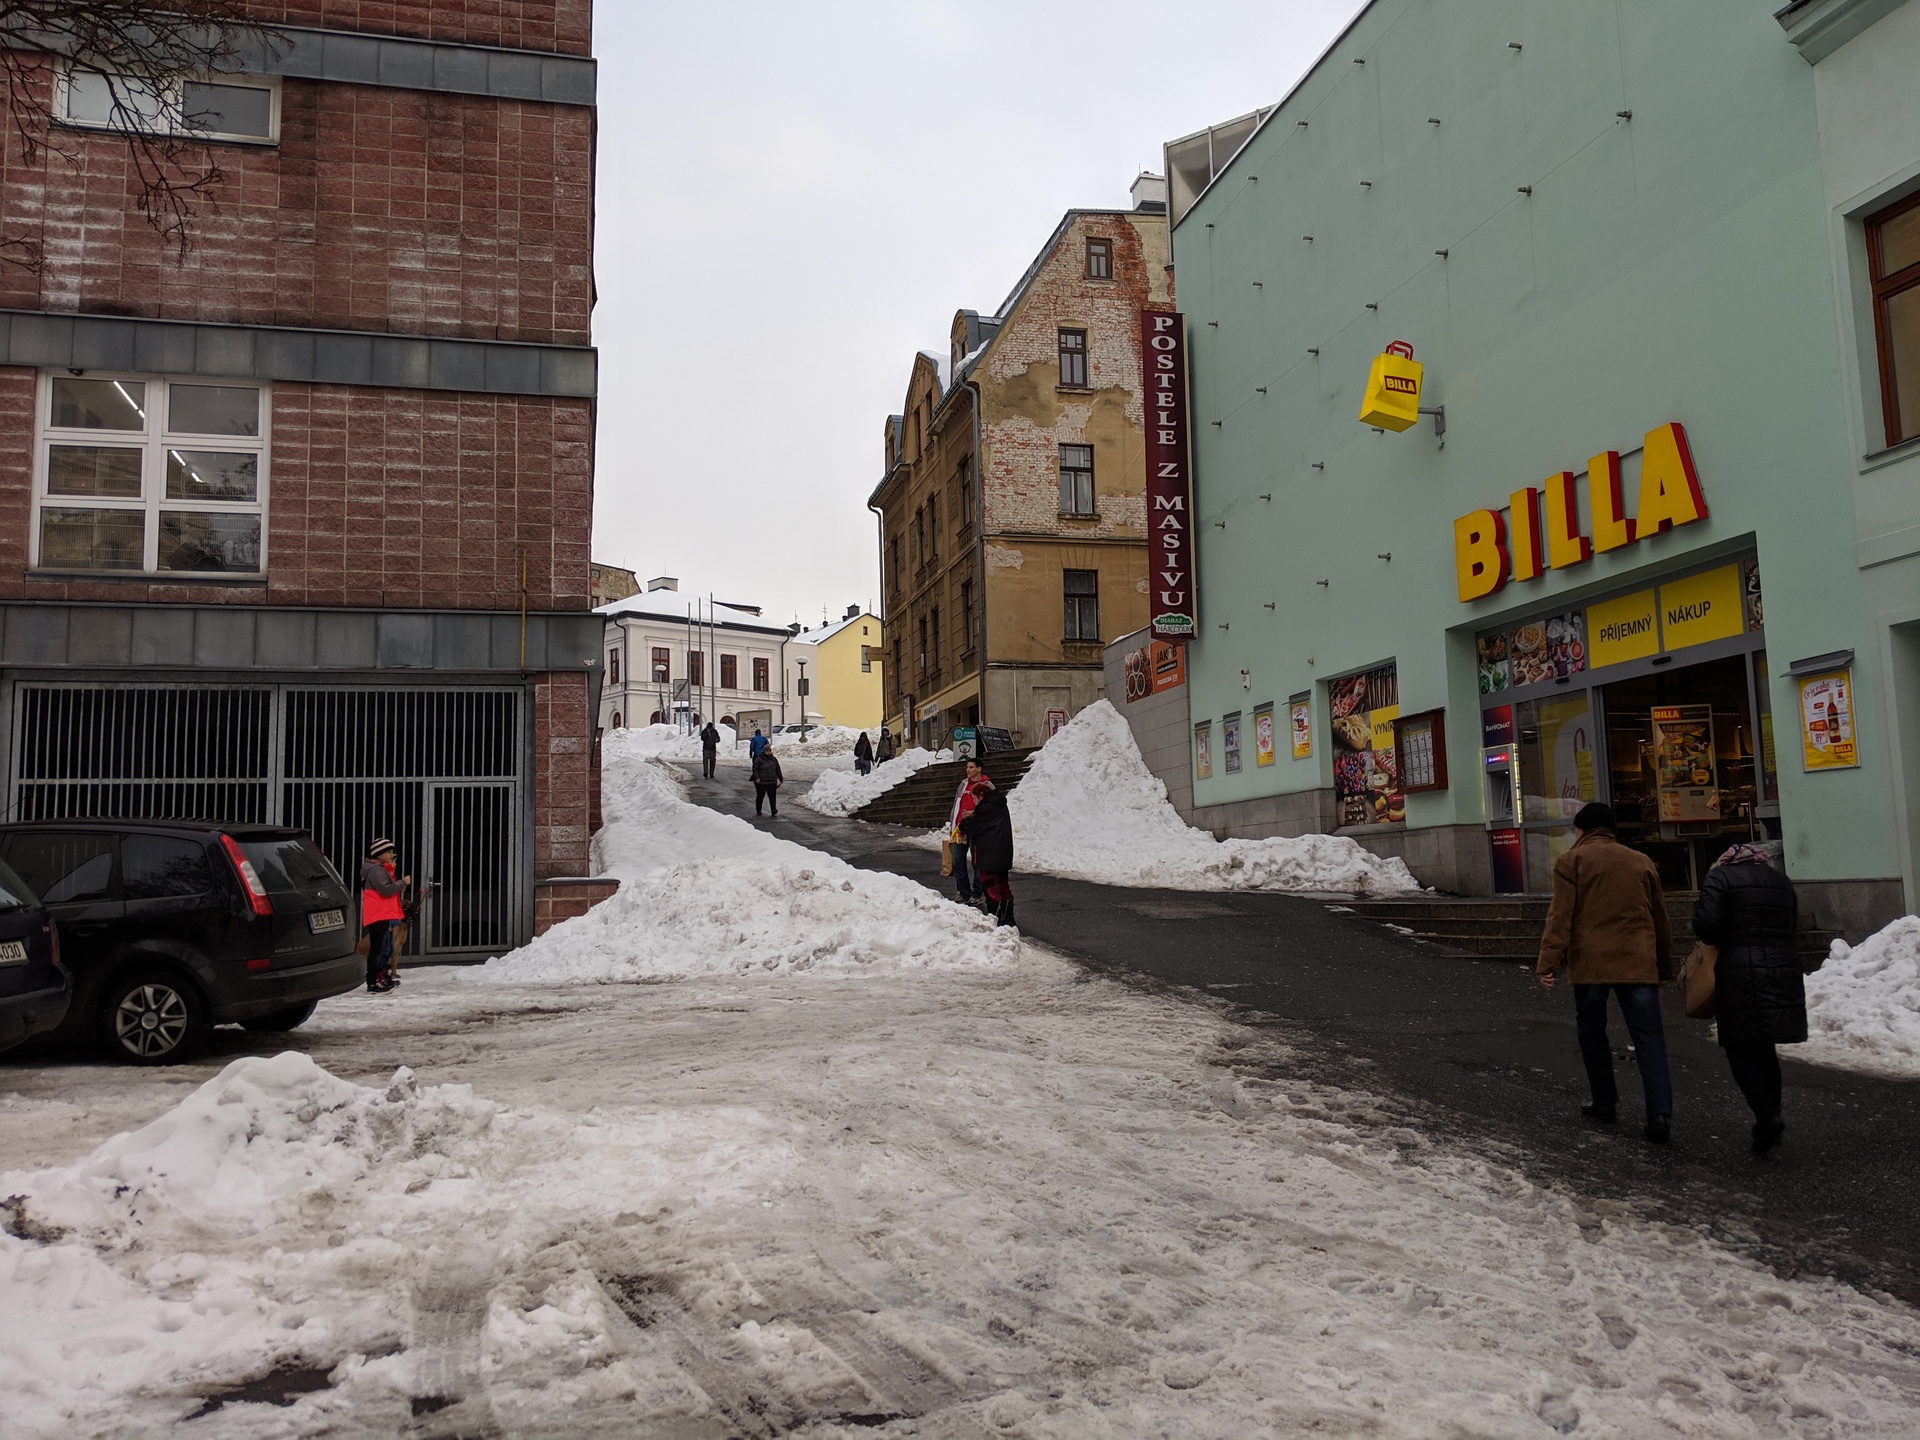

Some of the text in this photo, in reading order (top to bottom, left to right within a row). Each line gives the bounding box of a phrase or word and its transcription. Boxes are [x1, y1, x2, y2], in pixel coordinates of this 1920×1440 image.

[1386, 378, 1416, 392] BILLA
[1151, 316, 1185, 607] POSTELE Z MASIVU
[1454, 422, 1707, 603] BILLA
[1600, 601, 1711, 643] PŘÍJEMNÝ NÁKUP
[1485, 721, 1511, 732] BANKOMAT
[1654, 710, 1680, 719] BILLA
